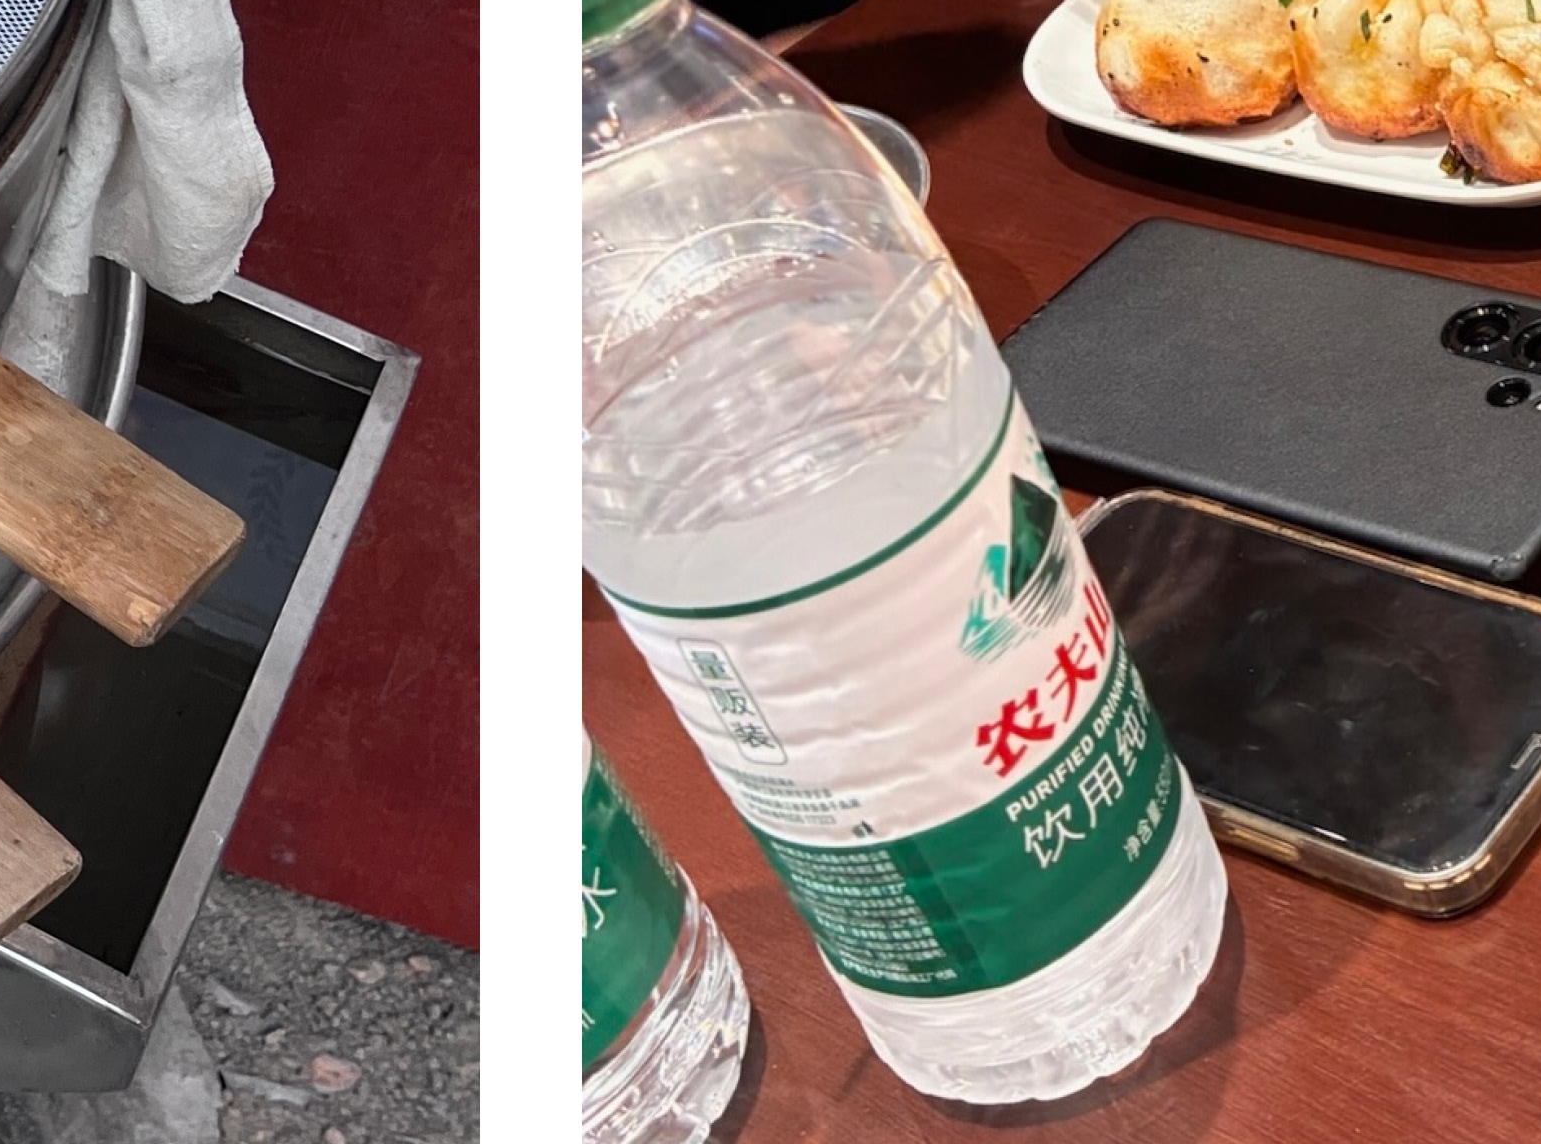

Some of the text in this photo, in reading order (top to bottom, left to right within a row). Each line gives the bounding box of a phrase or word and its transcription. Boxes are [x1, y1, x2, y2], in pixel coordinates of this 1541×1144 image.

[691, 650, 776, 750] 量贩装
[1006, 734, 1094, 822] PURIFIED
